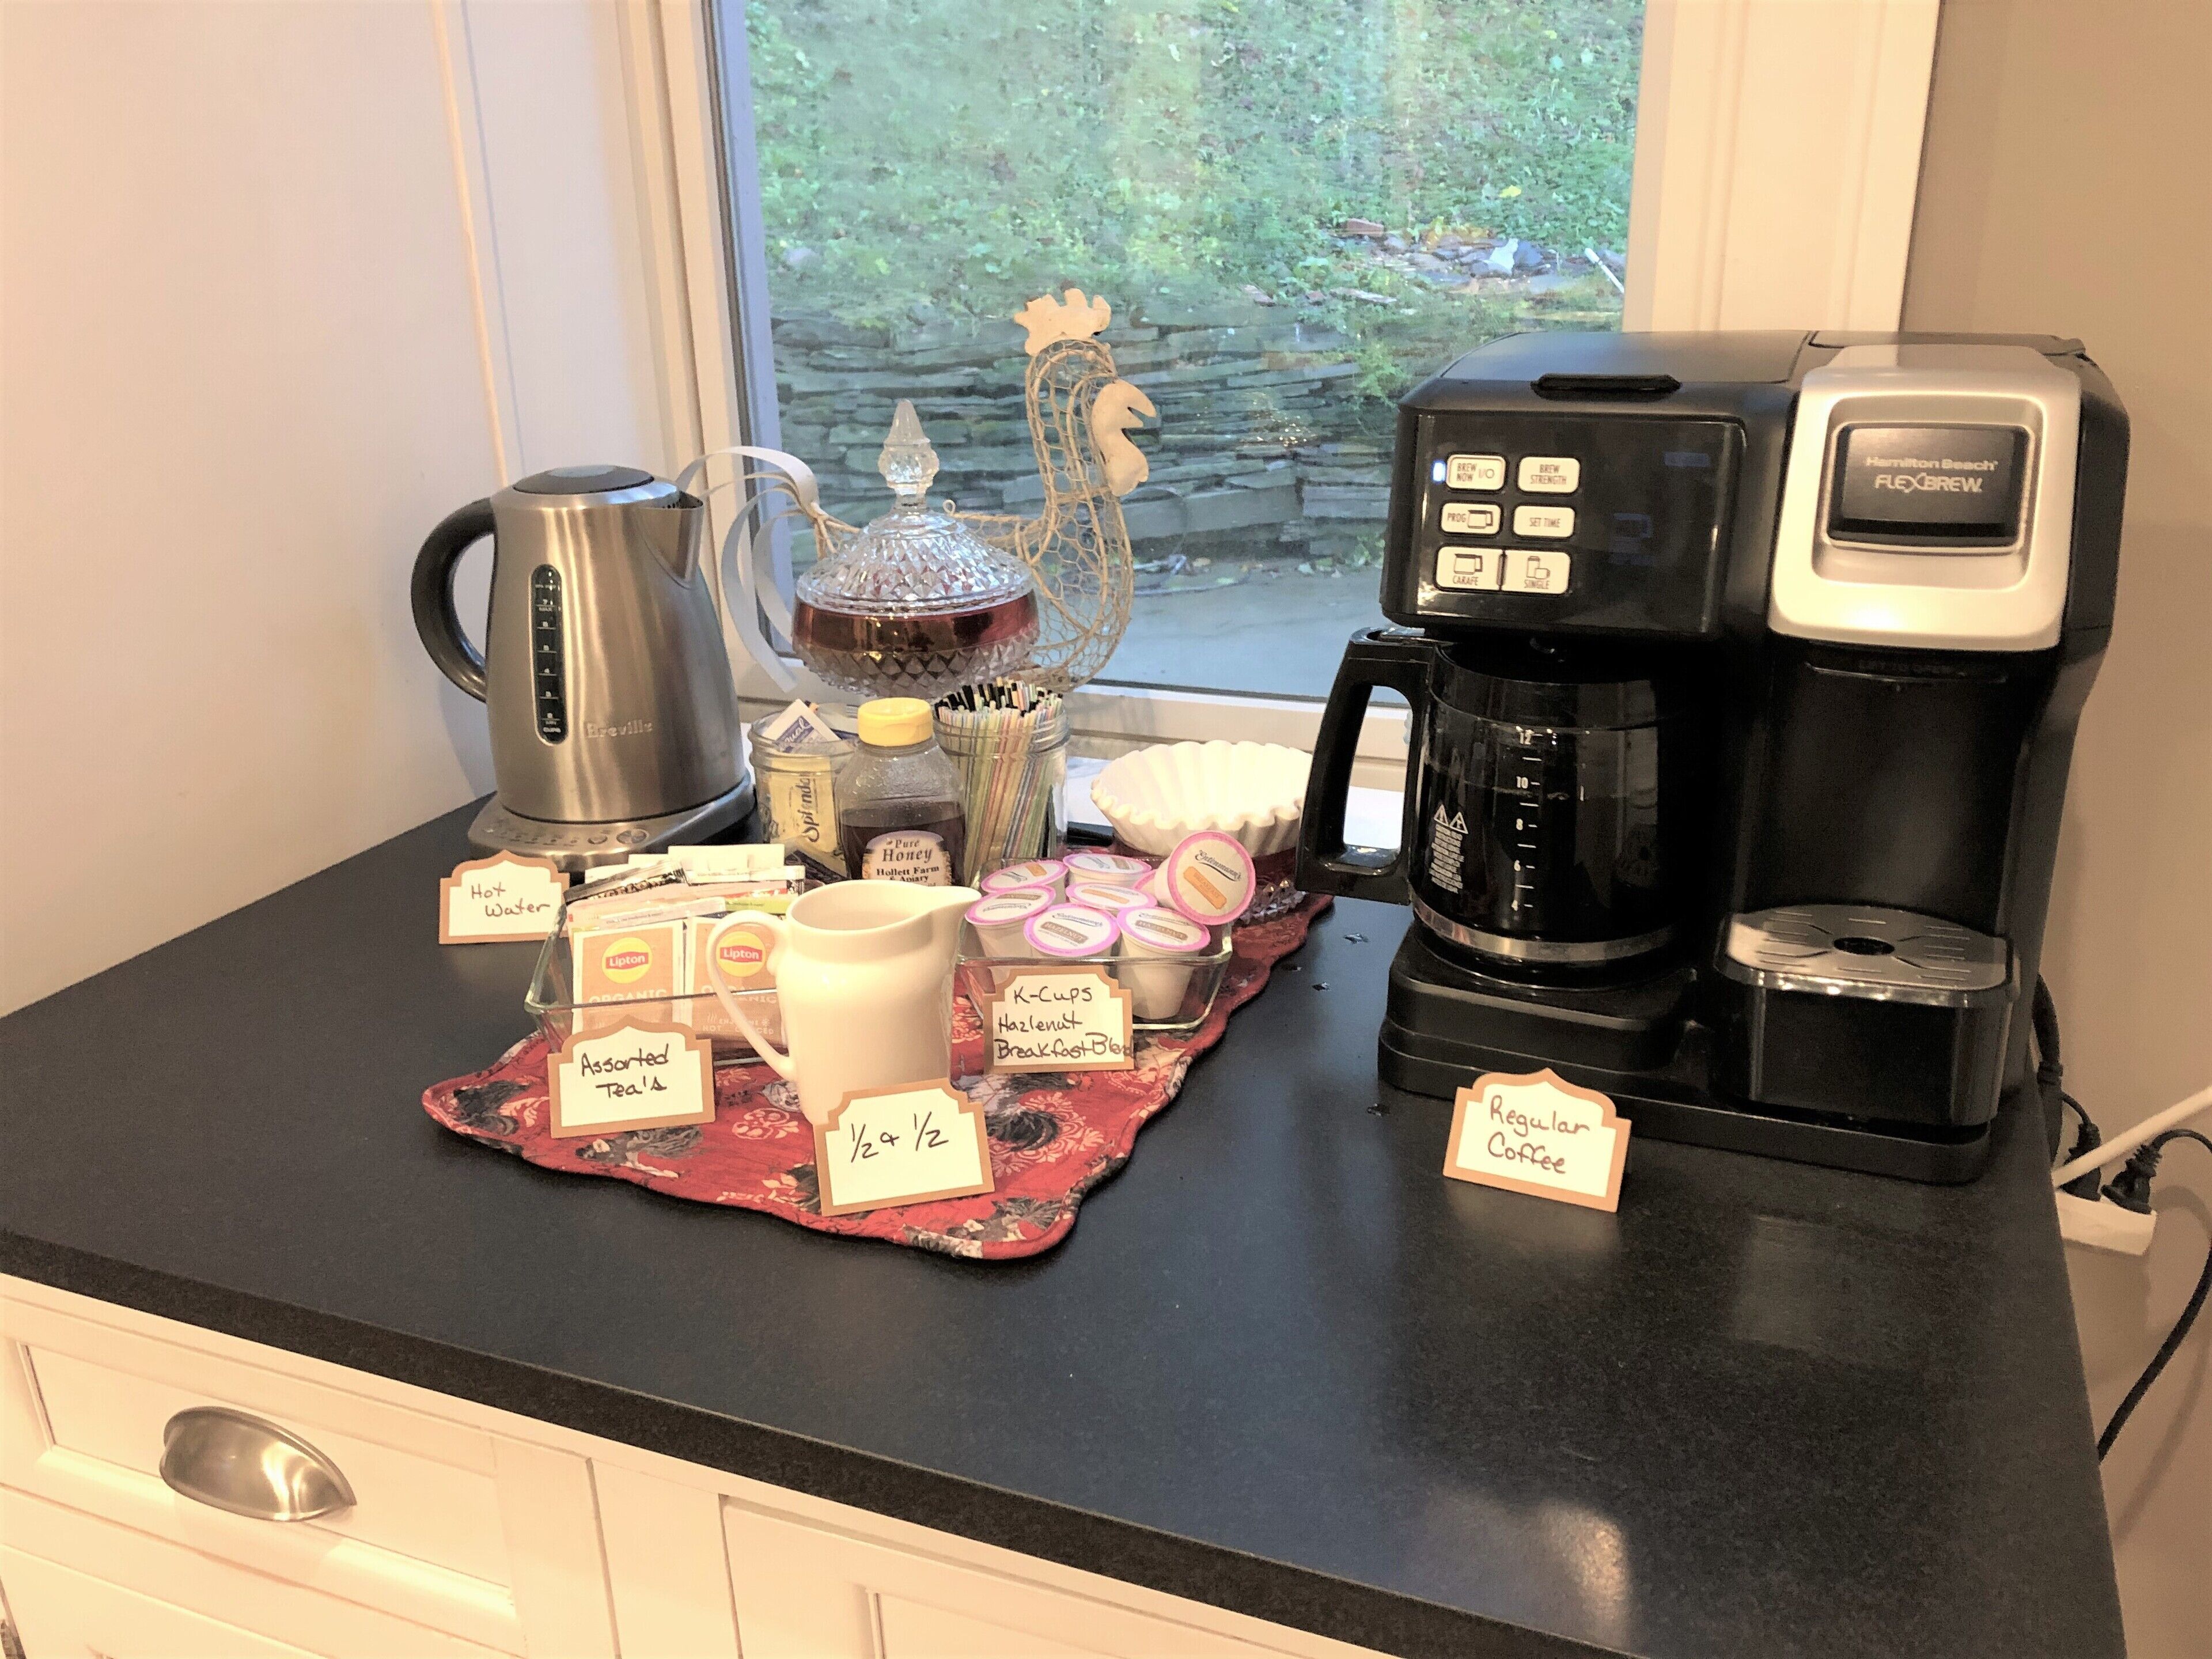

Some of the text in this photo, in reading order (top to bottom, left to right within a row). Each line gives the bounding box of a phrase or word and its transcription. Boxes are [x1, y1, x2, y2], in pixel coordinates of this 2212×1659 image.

[1457, 463, 1477, 472] BREW
[1539, 464, 1560, 474] BREW
[1866, 457, 1995, 471] Hamilton Beach
[1456, 472, 1474, 482] NOW
[1530, 475, 1567, 485] STRENGTH
[1874, 472, 1983, 493] FLEXBREW
[1446, 512, 1467, 523] PROG
[1452, 575, 1479, 586] CARAFE
[1516, 776, 1528, 789] 10
[1516, 819, 1524, 831] 8
[895, 839, 921, 849] Pure
[882, 848, 933, 863] Honey
[876, 866, 940, 876] Hollett Farm
[1513, 859, 1521, 872] 6
[471, 881, 506, 900] Hot
[484, 898, 551, 918] Water
[609, 954, 646, 968] Lipton
[723, 948, 760, 960] Lipton
[1013, 986, 1093, 1005] K-Cups
[998, 1010, 1083, 1034] Hazlenut
[994, 1032, 1135, 1060] Breakfast Blend
[581, 1043, 670, 1077] Assorted
[595, 1075, 668, 1099] Tea's
[1490, 1094, 1590, 1138] Regular
[1487, 1131, 1566, 1175] Coffee
